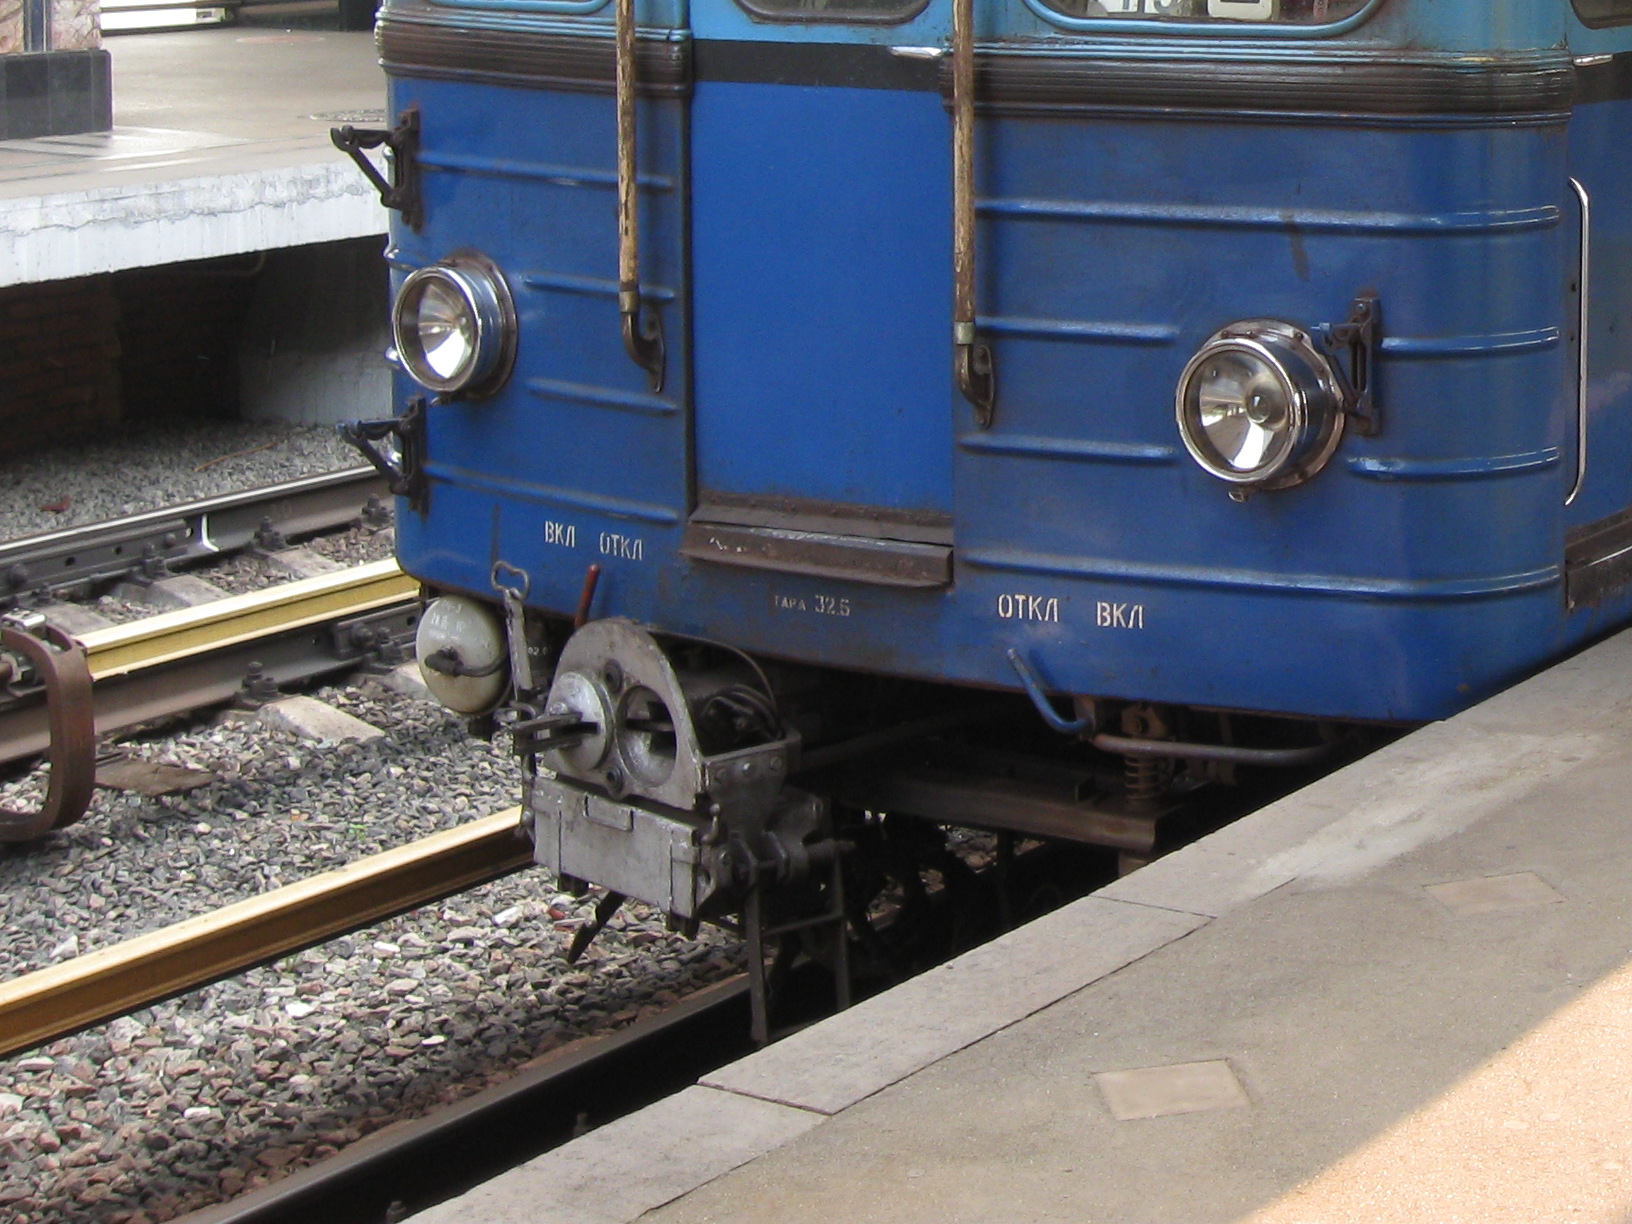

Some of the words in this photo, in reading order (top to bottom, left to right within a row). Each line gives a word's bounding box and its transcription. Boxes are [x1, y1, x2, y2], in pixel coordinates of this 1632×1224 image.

[545, 520, 575, 548] ВКЛ
[599, 531, 642, 560] ОТКЛ
[774, 596, 806, 611] ТАРА
[998, 593, 1058, 622] ОТКЛ
[1097, 601, 1144, 629] ВКЛ
